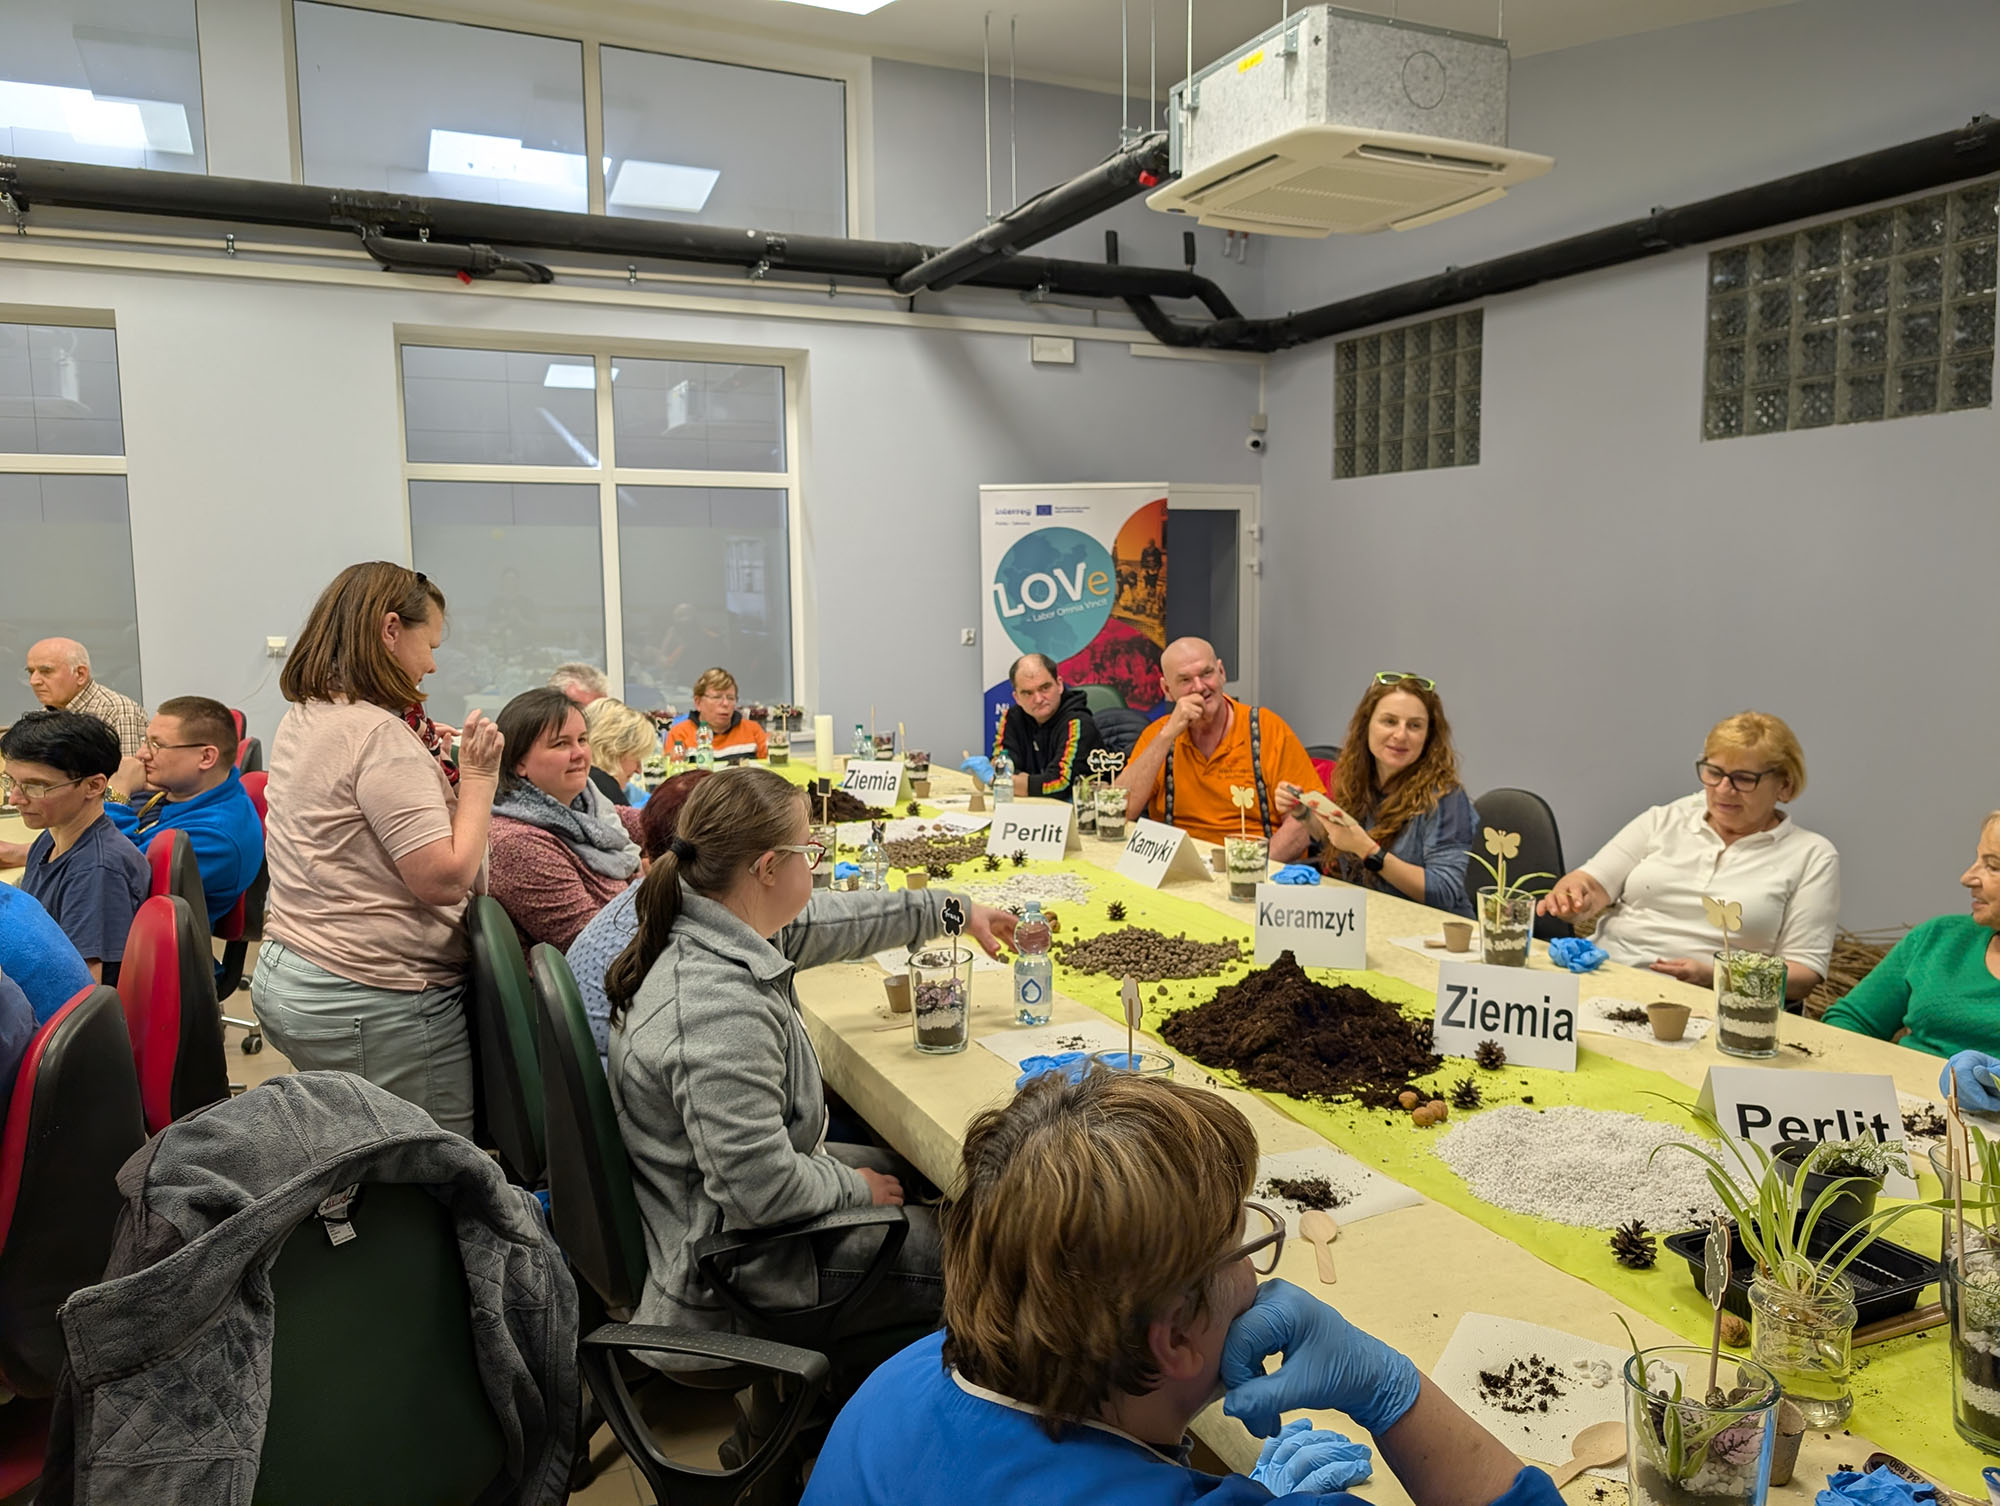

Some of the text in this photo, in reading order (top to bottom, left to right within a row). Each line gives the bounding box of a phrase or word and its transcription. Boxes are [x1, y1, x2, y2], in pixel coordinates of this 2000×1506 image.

[993, 562, 1110, 618] LOVe
[843, 769, 897, 791] Ziemia
[1002, 822, 1063, 843] Perlit
[1126, 829, 1176, 863] Kamyki
[1259, 901, 1355, 936] Keramzyt
[1441, 984, 1574, 1042] Ziemia
[1736, 1103, 1889, 1144] Perlit
